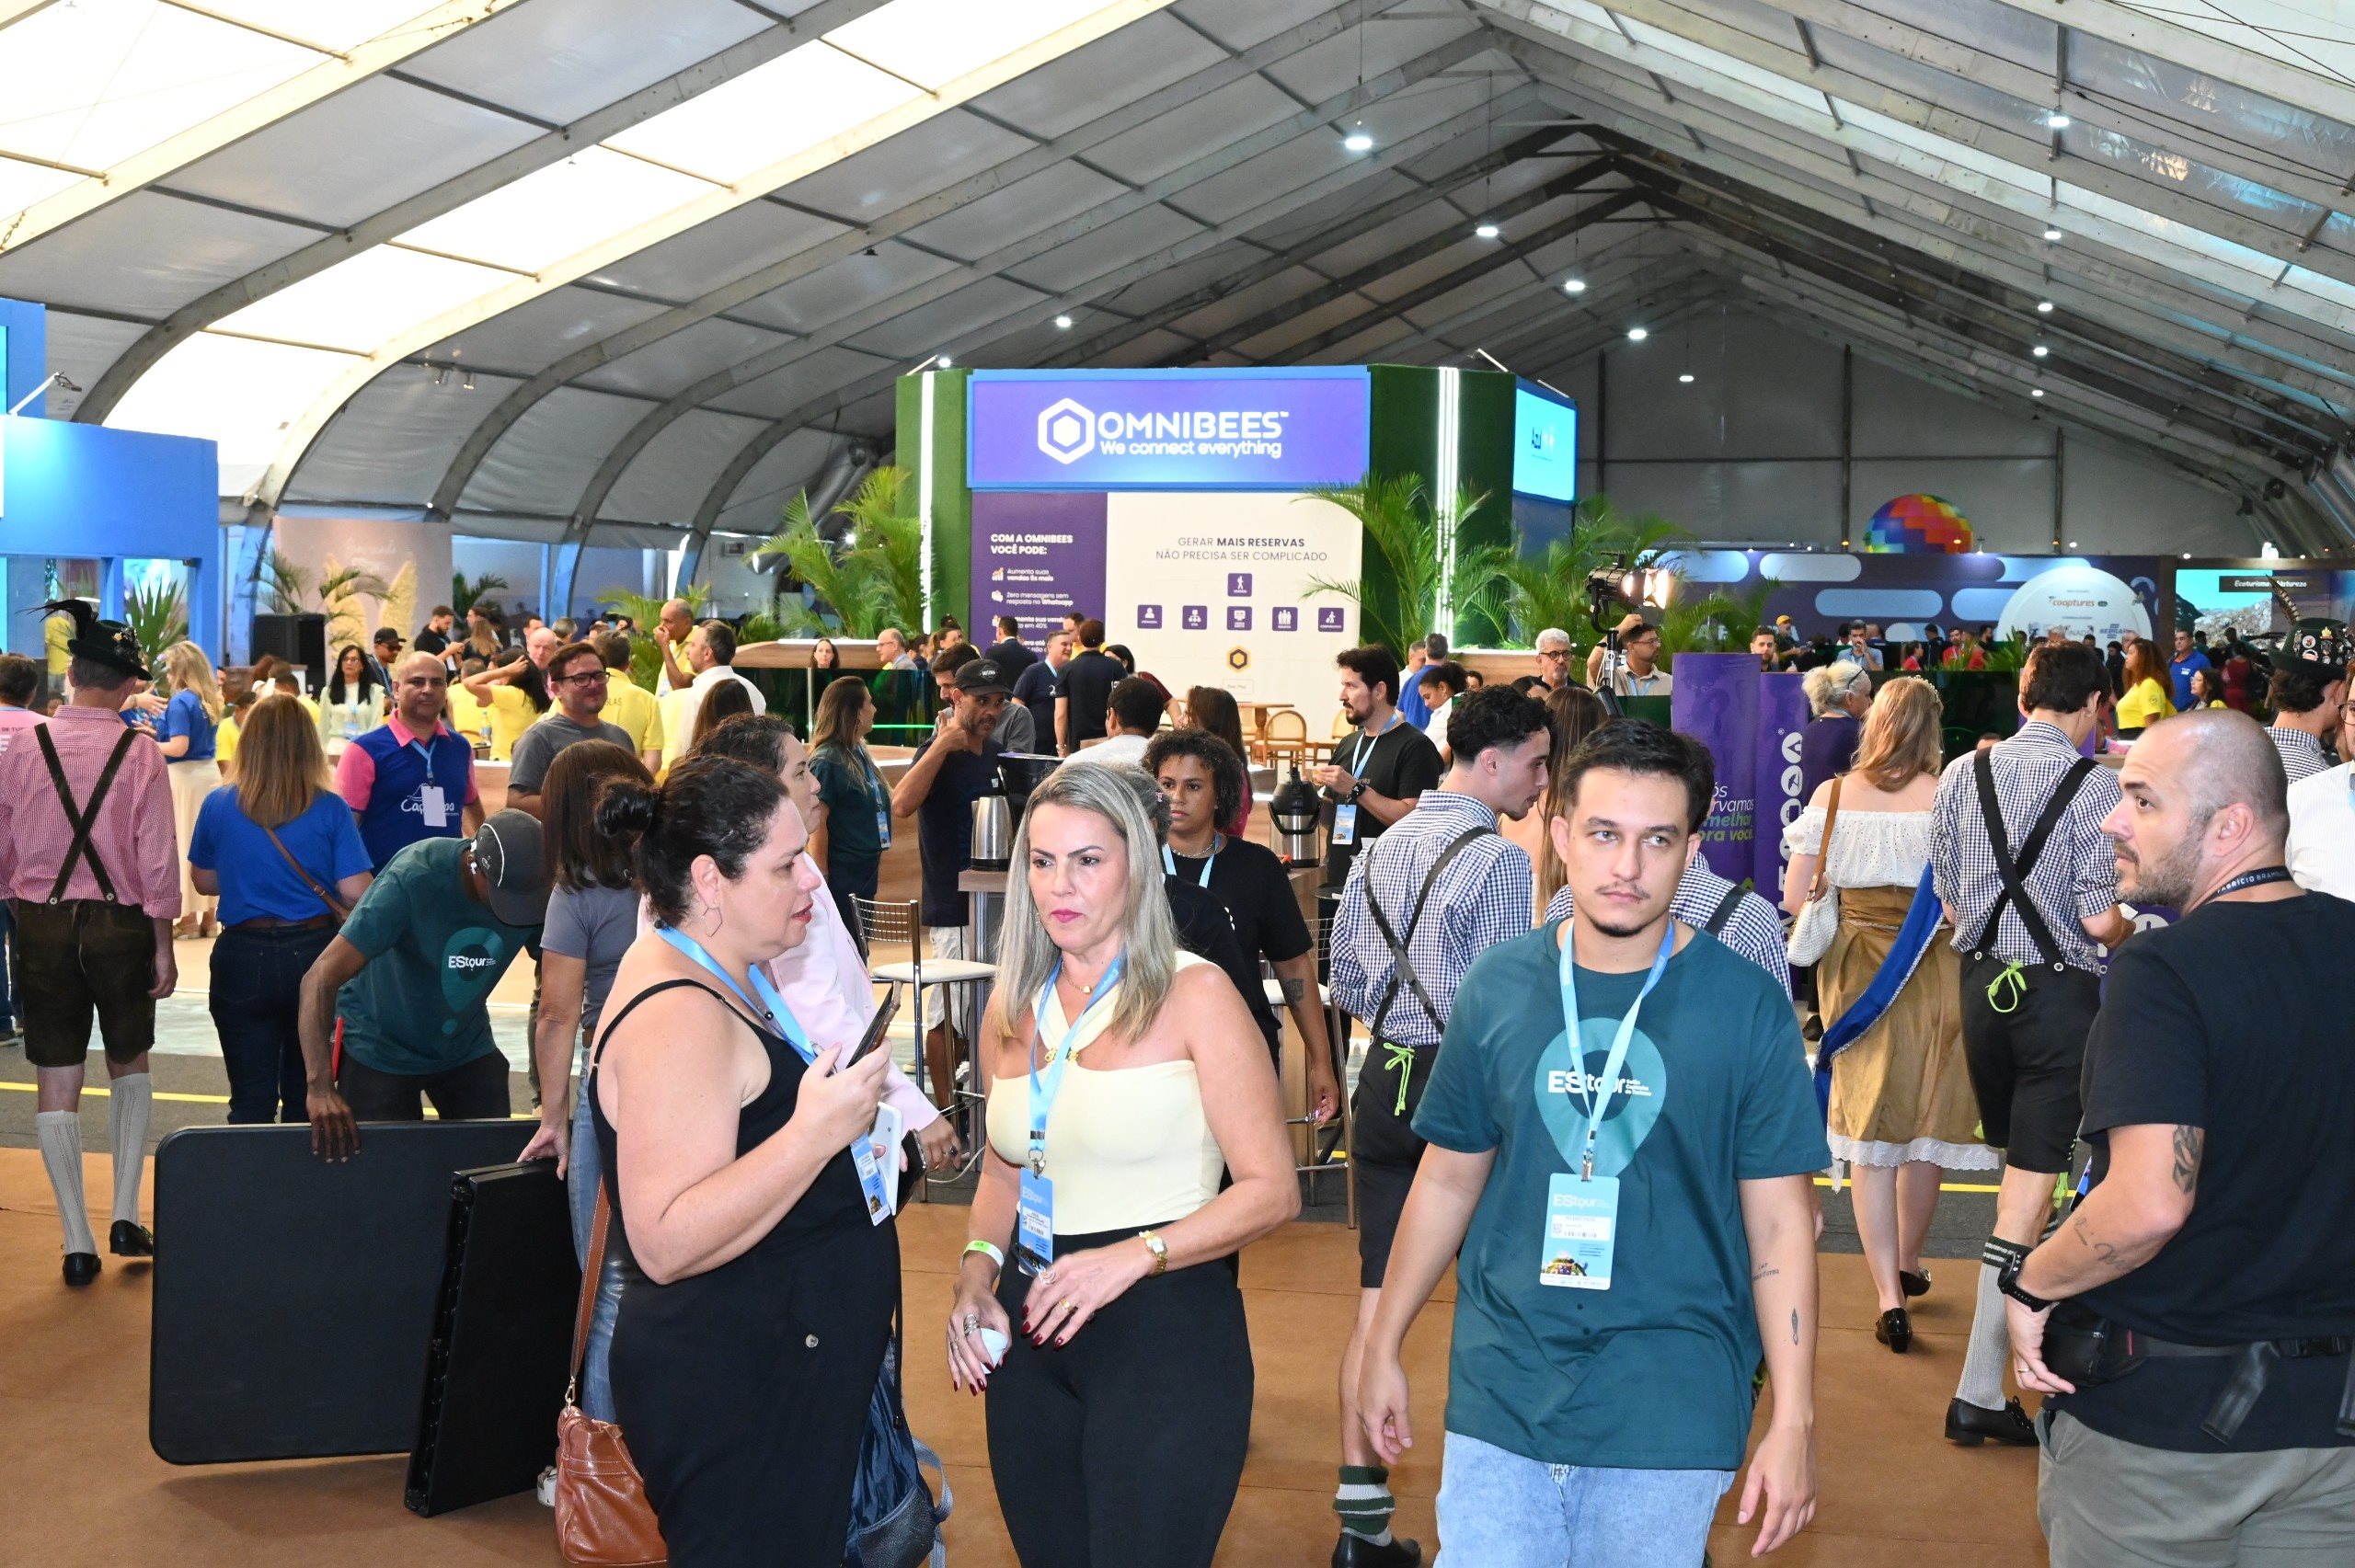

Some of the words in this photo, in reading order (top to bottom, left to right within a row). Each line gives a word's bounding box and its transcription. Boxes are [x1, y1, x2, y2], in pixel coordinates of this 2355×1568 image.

[1097, 411, 1282, 440] OMNIBEES
[1100, 441, 1126, 454] We
[1129, 441, 1195, 455] connect
[1198, 440, 1282, 459] everything
[991, 533, 1014, 543] COM
[1015, 534, 1023, 544] A
[1024, 534, 1074, 544] OMNIBEES
[1178, 537, 1213, 546] GERAR
[1216, 538, 1246, 547] MAIS
[1247, 538, 1305, 547] RESERVAS
[991, 544, 1018, 555] VOCÊ
[1018, 545, 1048, 555] PODE:
[1155, 549, 1180, 560] NÃO
[1183, 550, 1227, 560] PRECISA
[1230, 552, 1249, 560] SER
[1252, 552, 1327, 562] COMPLICADO
[448, 955, 487, 970] EStour
[1547, 1070, 1626, 1094] EStor
